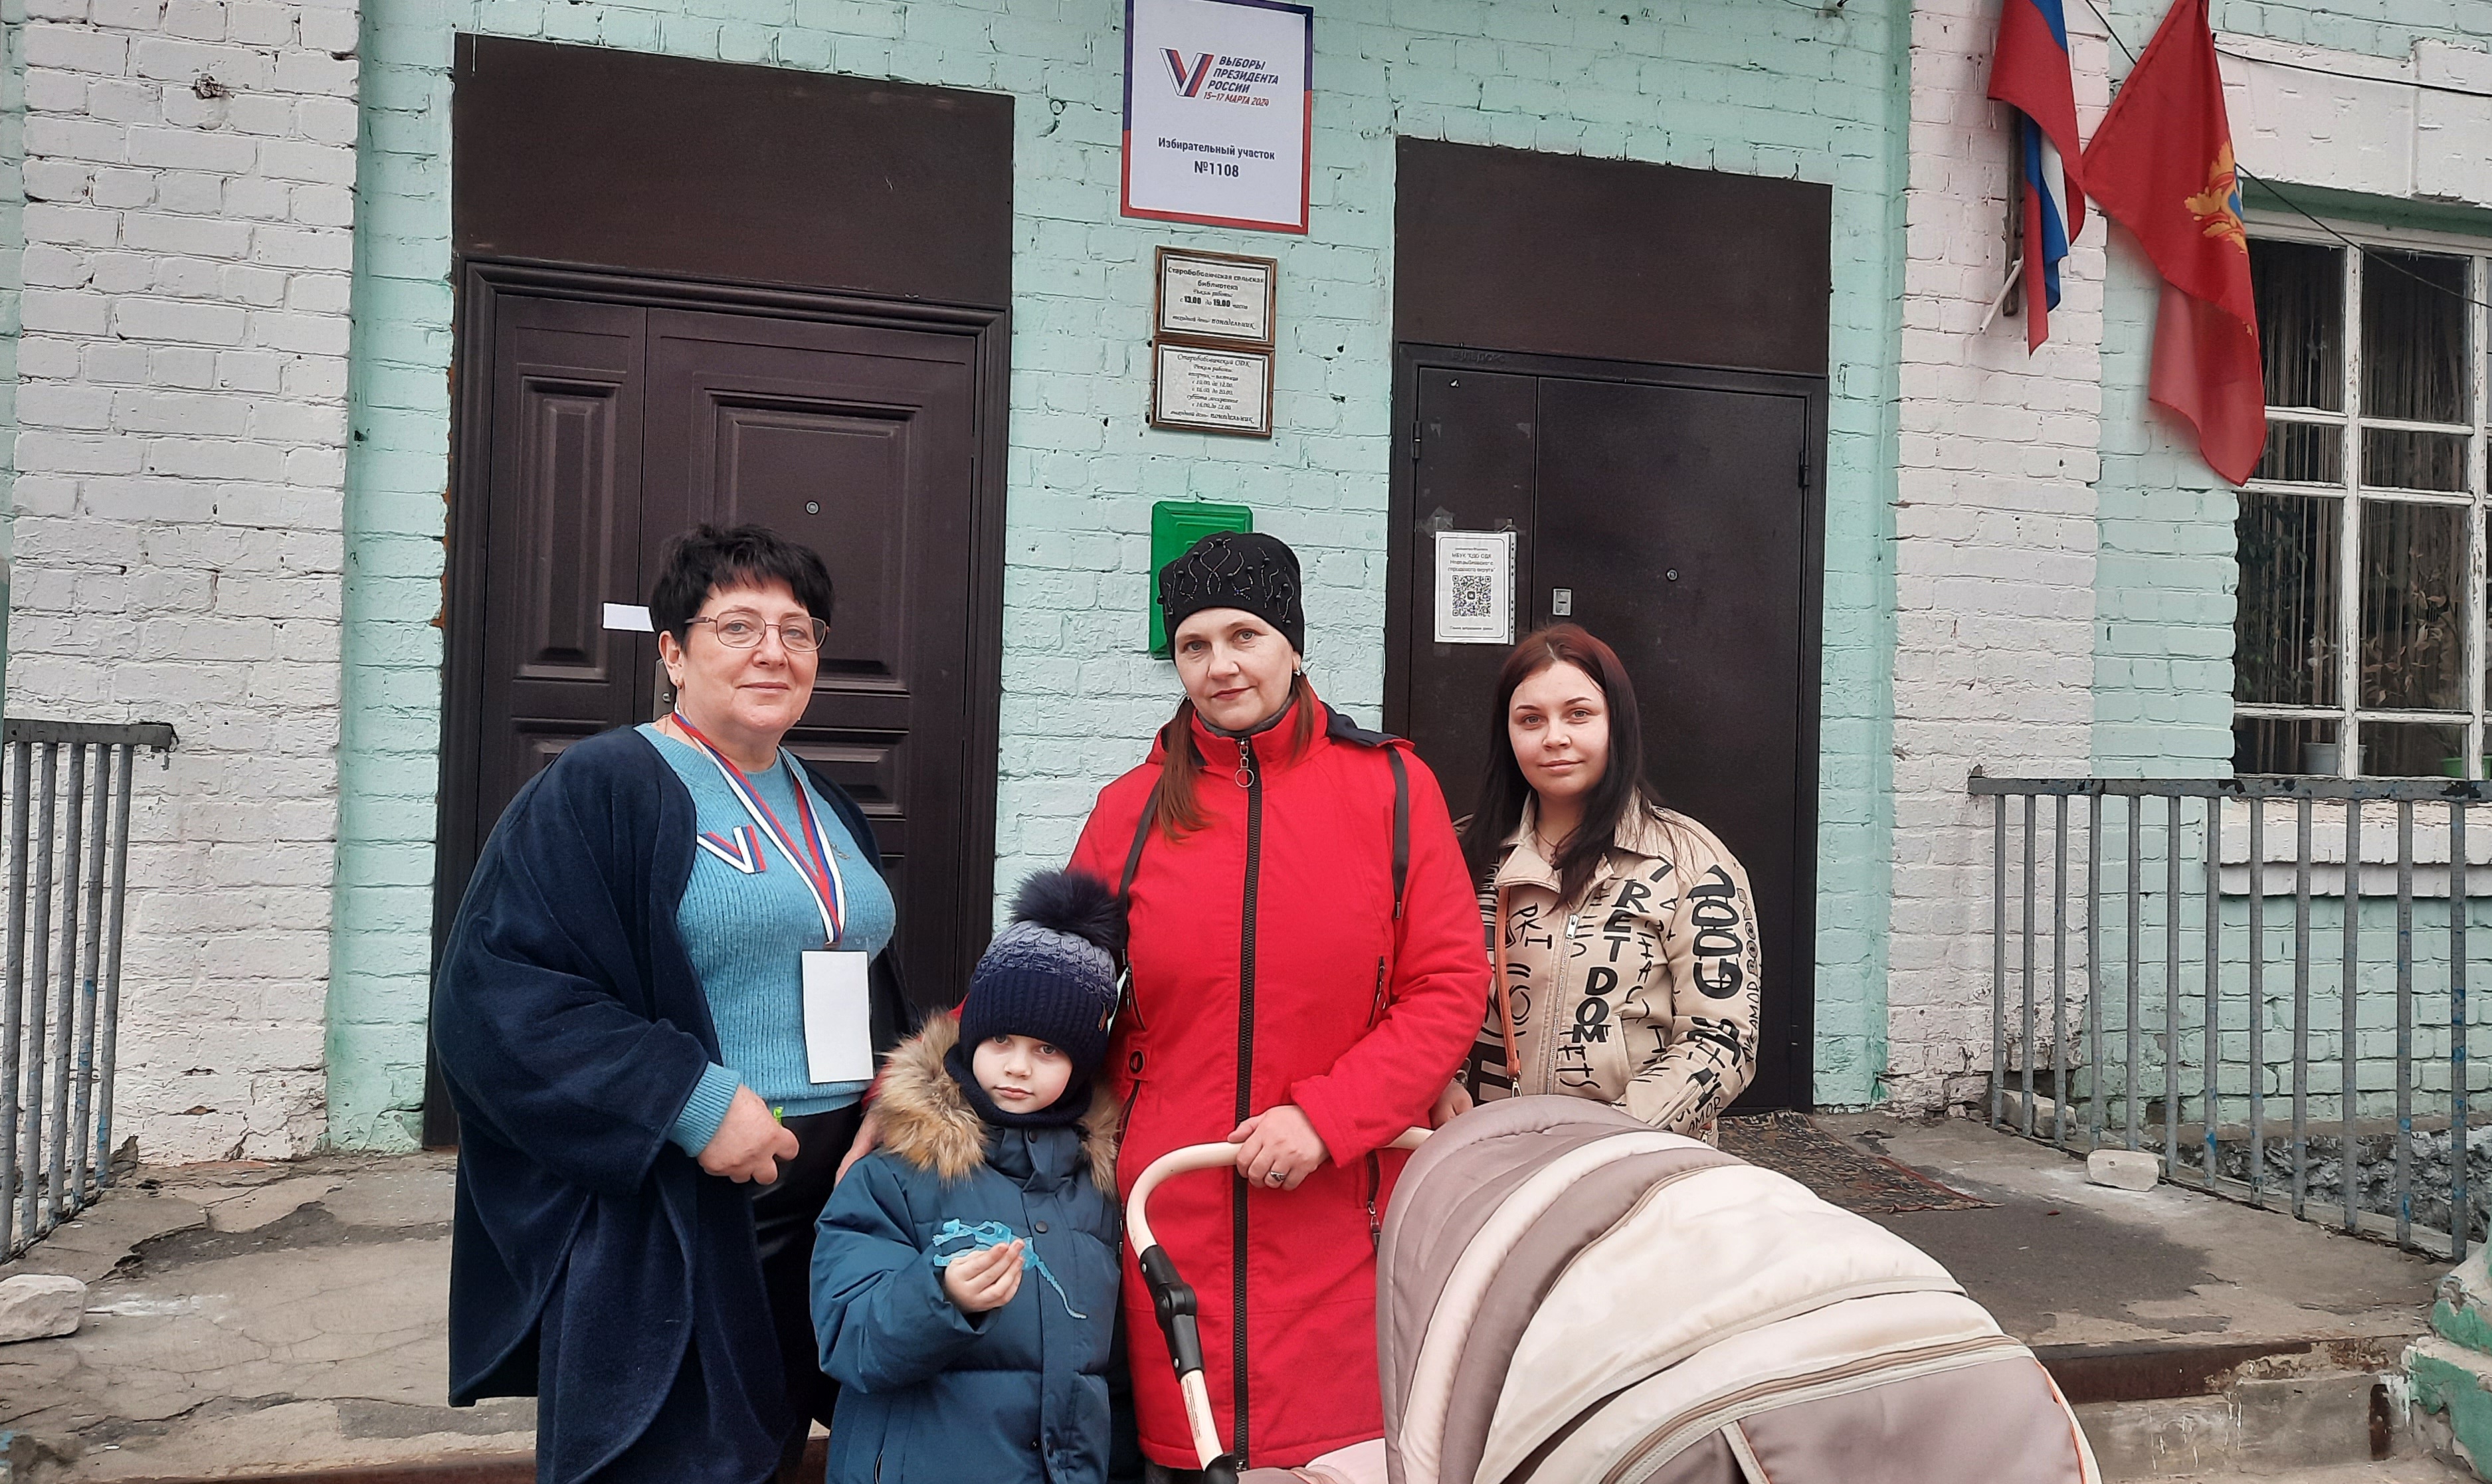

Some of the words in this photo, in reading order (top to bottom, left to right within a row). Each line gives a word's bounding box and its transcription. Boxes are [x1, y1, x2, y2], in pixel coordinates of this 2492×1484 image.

[1218, 56, 1266, 71] ВЫБОРЫ
[1213, 68, 1279, 85] ПРЕЗИДЕНТА
[1208, 80, 1250, 94] РОССИИ
[1224, 94, 1250, 105] МАРТА
[1250, 98, 1270, 106] 2024
[1158, 137, 1235, 156] Избирательный
[1237, 147, 1275, 160] участок
[1194, 161, 1239, 177] №1108
[1198, 280, 1238, 290] библиотека
[1687, 1097, 1724, 1135] AMOR
